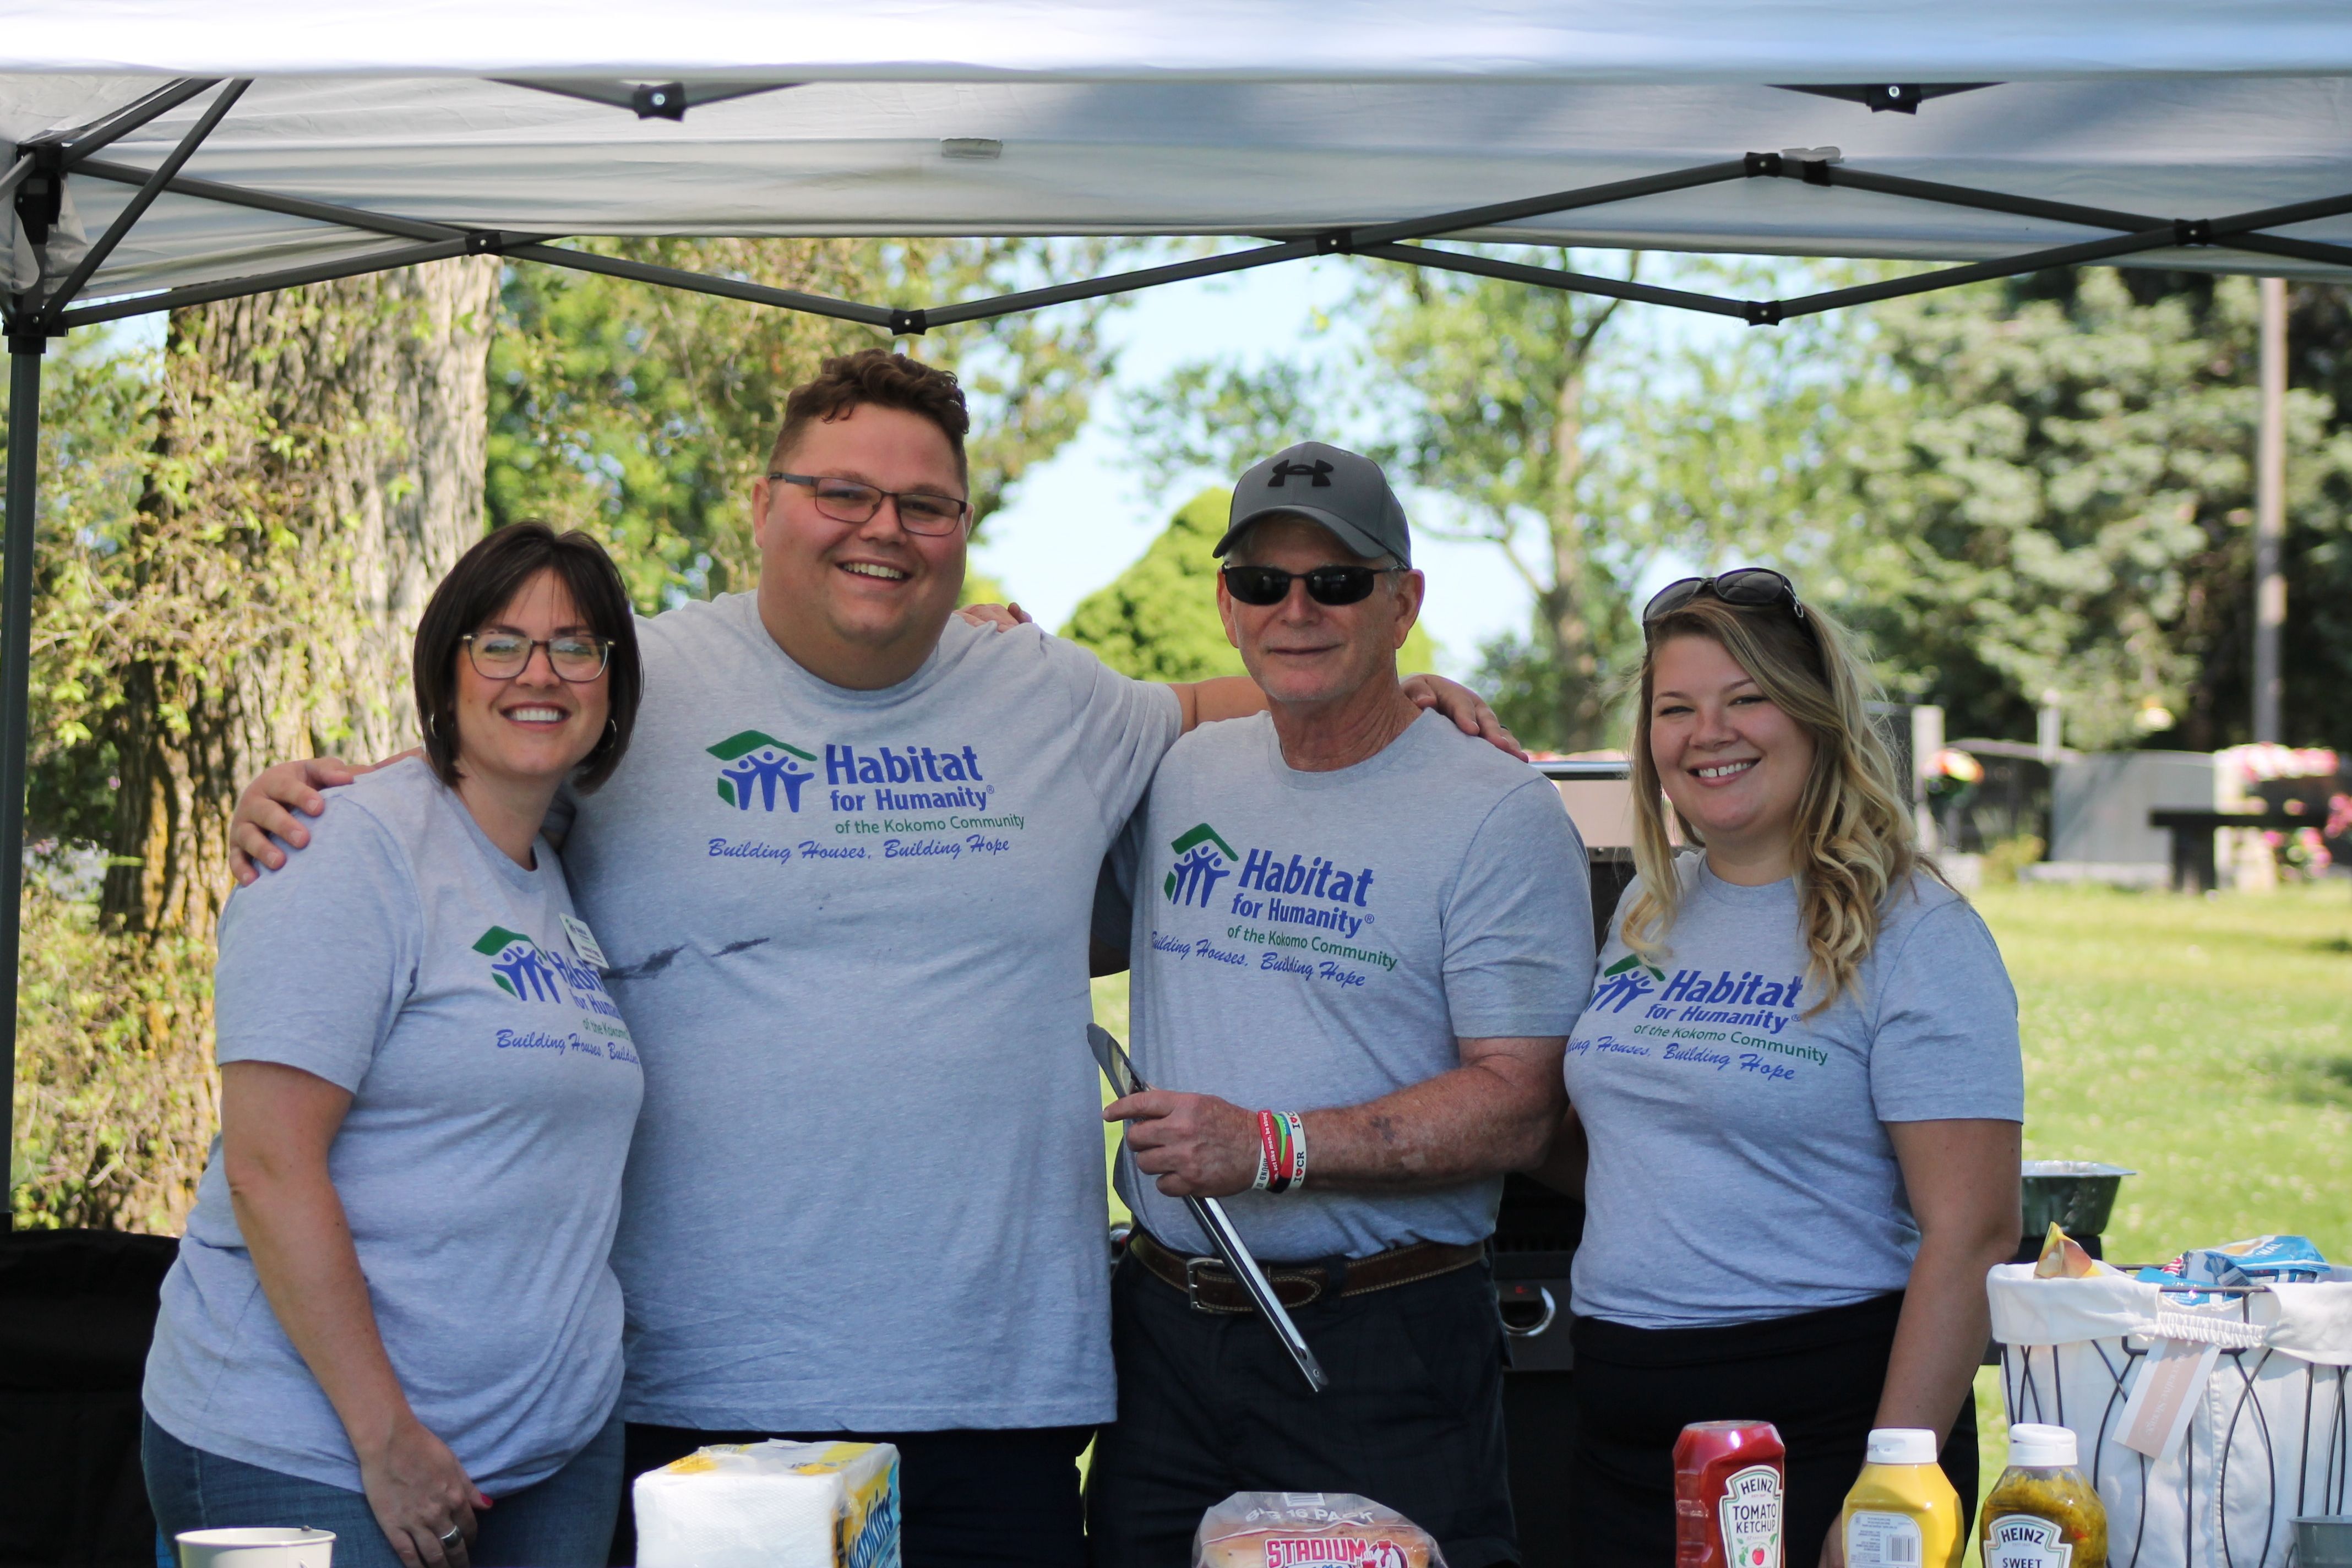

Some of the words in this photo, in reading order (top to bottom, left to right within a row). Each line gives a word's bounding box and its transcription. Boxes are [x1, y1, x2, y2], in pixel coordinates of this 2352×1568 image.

[826, 744, 983, 785] Habitat
[830, 790, 863, 811] for
[835, 821, 852, 834] of
[855, 820, 880, 833] the
[884, 817, 946, 832] Kokomo
[950, 814, 1025, 830] Community
[708, 839, 792, 864] Building
[883, 839, 961, 859] Building
[967, 835, 1010, 856] Hope
[1238, 848, 1374, 907] Habitat
[1231, 893, 1263, 919] for
[1228, 925, 1242, 938] of
[1244, 928, 1265, 944] the
[1268, 930, 1308, 948] Kokomo
[1311, 936, 1397, 971] Community
[1260, 952, 1314, 978] Building
[1319, 961, 1365, 988] Hope
[569, 988, 589, 1011] for
[1660, 970, 1803, 1008] Habitat
[1645, 1004, 1676, 1020] for
[583, 1018, 590, 1031] of
[496, 1029, 565, 1055] Building
[1634, 1025, 1651, 1035] of
[1649, 1026, 1668, 1038] the
[1672, 1028, 1726, 1041] Kokomo
[1731, 1031, 1828, 1065] Community
[1663, 1043, 1730, 1071] Building
[1739, 1053, 1795, 1081] Hope
[1297, 1151, 1304, 1167] CR
[1741, 1477, 1773, 1495] HEINZ
[1286, 1509, 1309, 1517] 16
[1733, 1503, 1777, 1521] TOMATO
[1736, 1520, 1776, 1533] KETCHUP
[2001, 1527, 2044, 1545] HEINZ
[1266, 1538, 1368, 1568] STADIUM
[2003, 1558, 2043, 1568] SWEET
